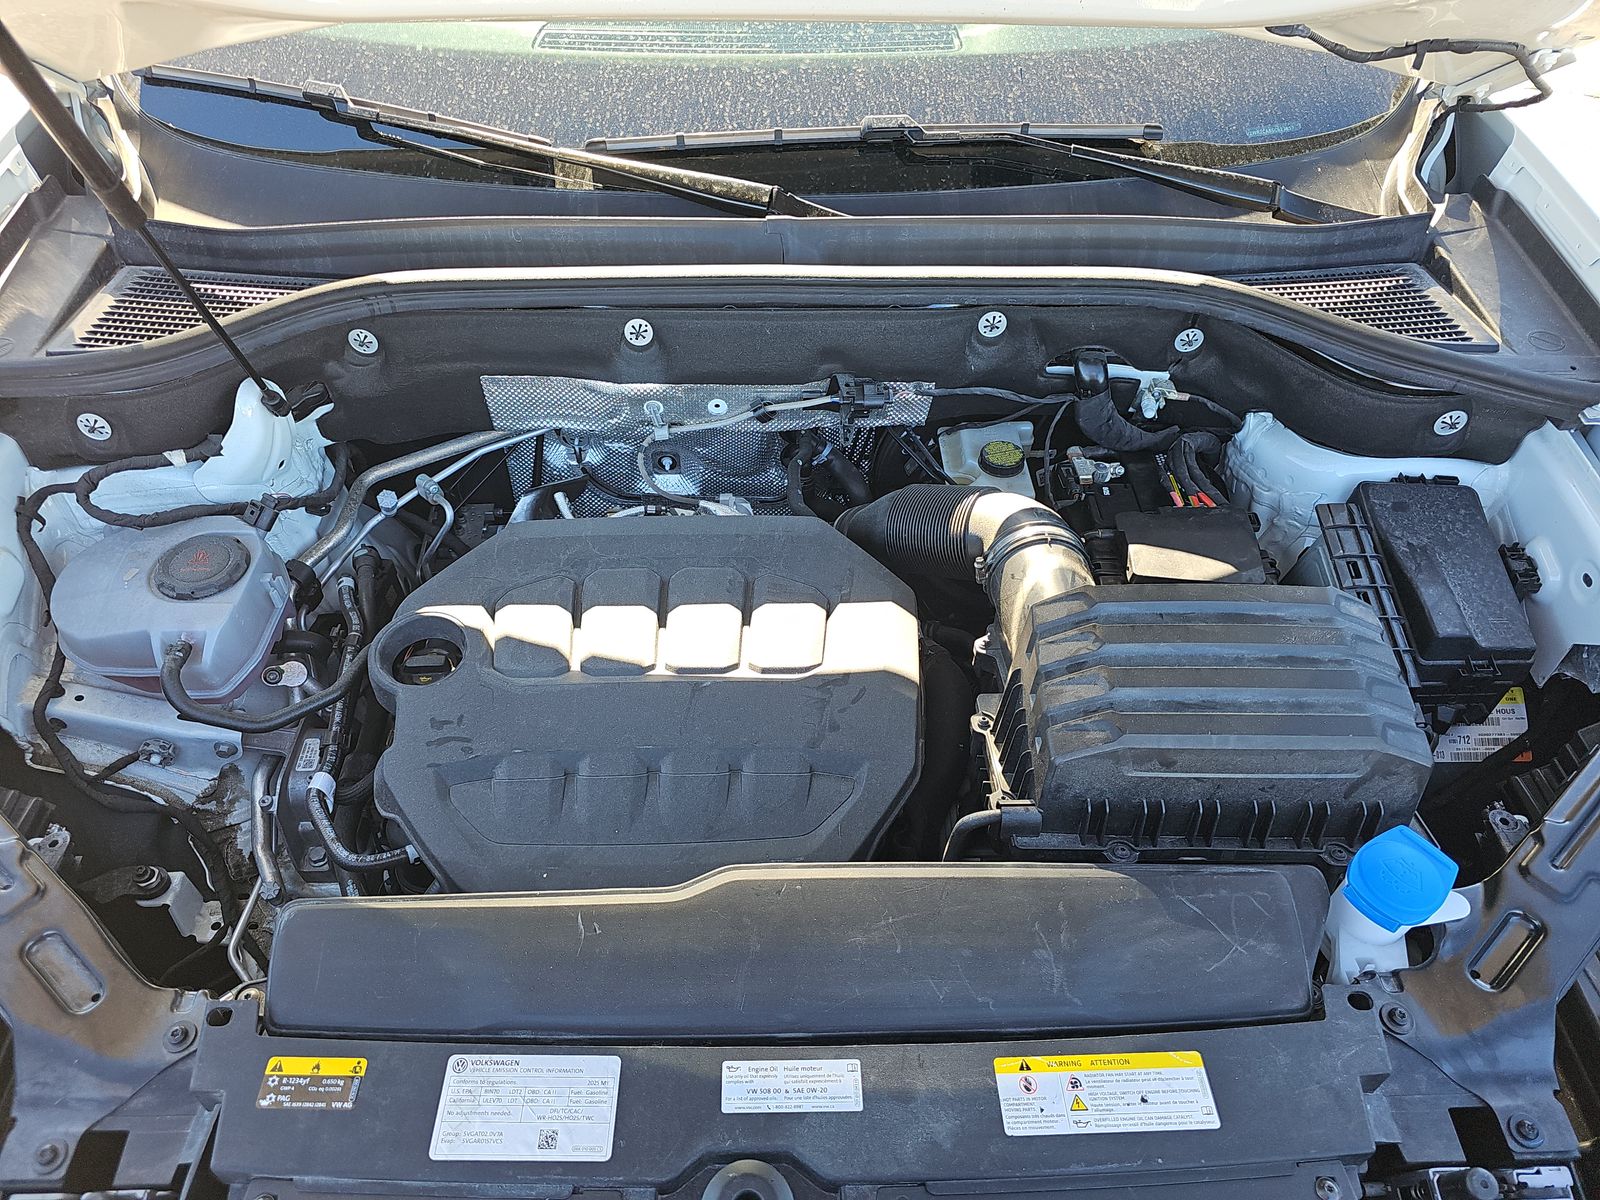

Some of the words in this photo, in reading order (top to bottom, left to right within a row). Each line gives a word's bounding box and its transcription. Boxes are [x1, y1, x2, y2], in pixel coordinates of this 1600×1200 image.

[1457, 735, 1470, 745] 712
[1046, 1060, 1082, 1068] WARNING
[282, 1077, 311, 1086] R-1234yf
